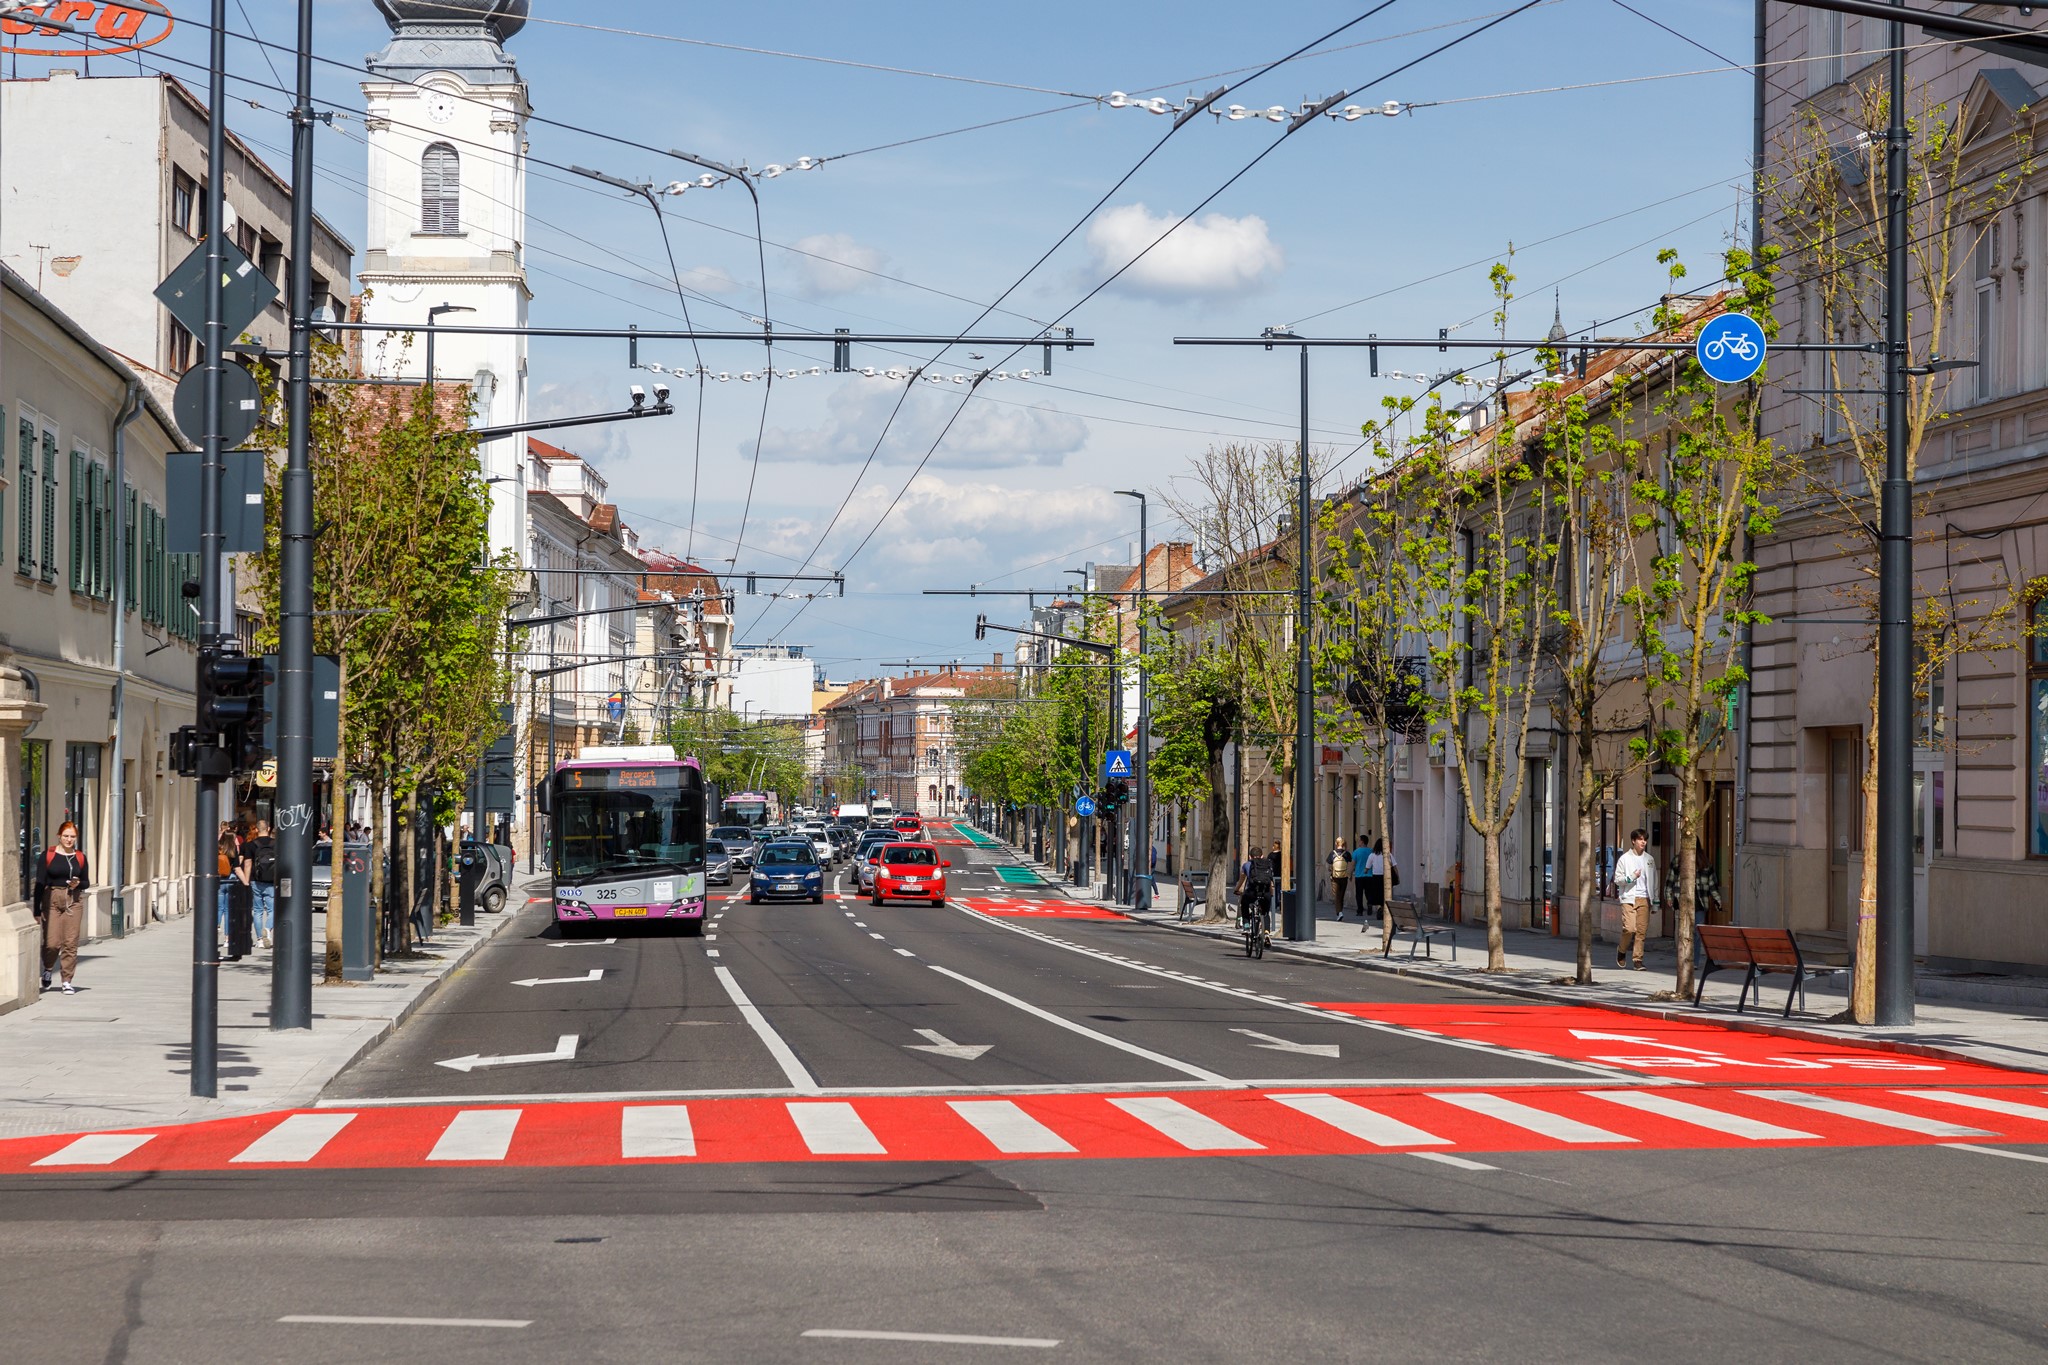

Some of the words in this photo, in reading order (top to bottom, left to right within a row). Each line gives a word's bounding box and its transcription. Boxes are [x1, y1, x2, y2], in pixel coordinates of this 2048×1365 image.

[574, 771, 583, 788] 5
[620, 770, 655, 779] Aeroport
[596, 889, 617, 900] 325
[1585, 1055, 1946, 1072] BUS
